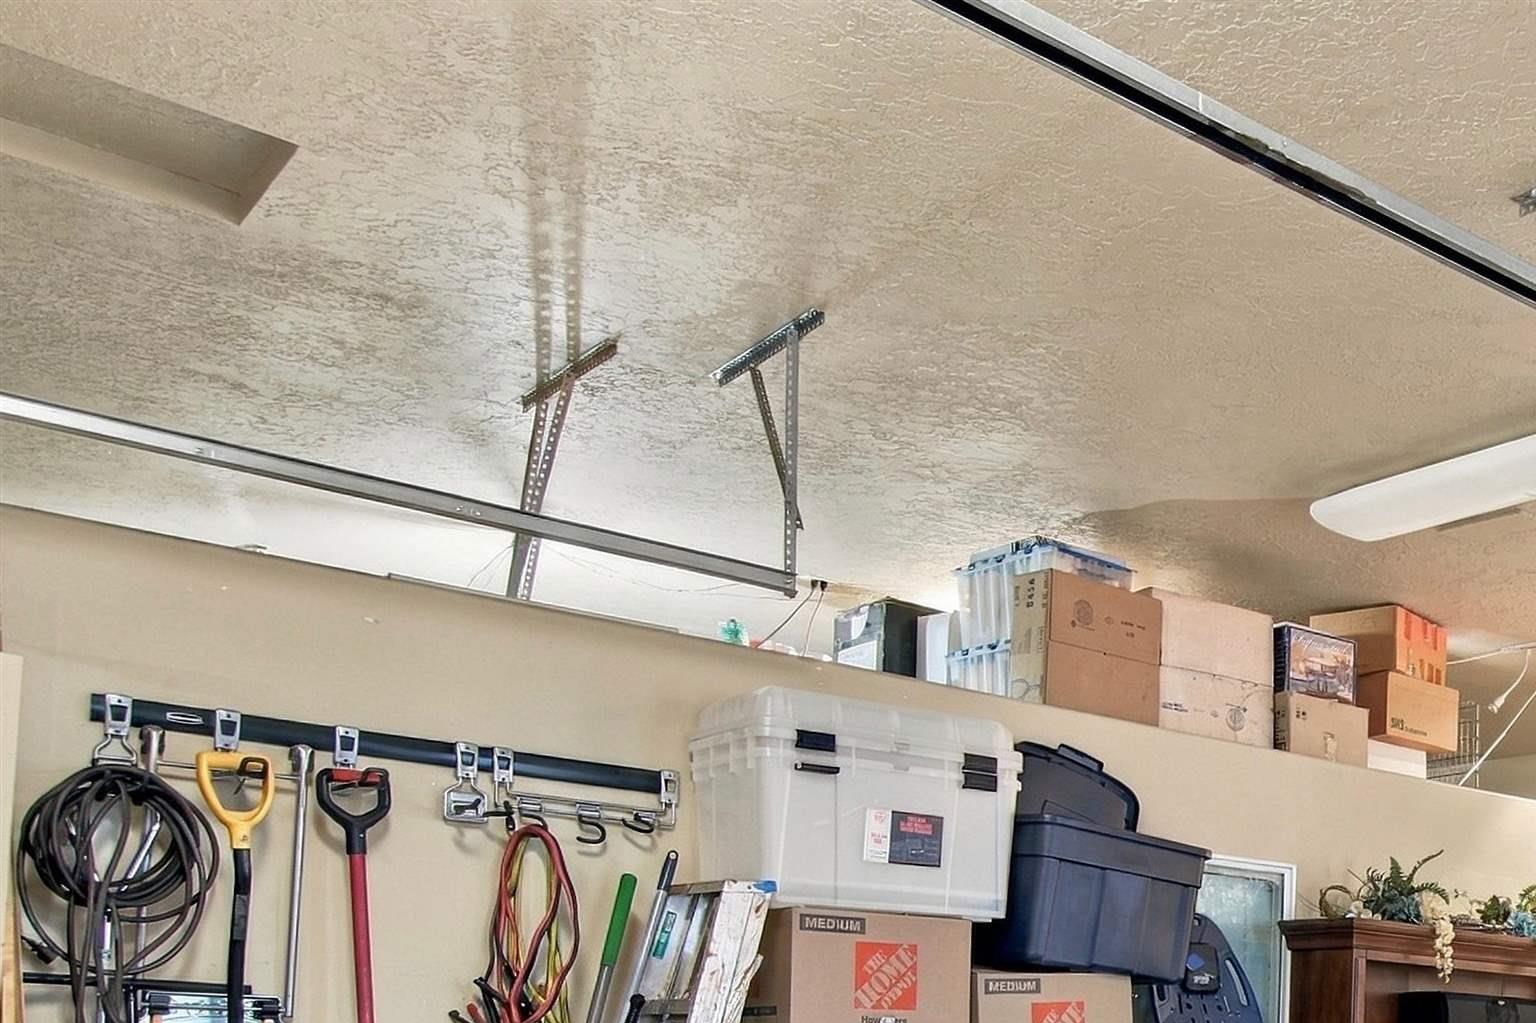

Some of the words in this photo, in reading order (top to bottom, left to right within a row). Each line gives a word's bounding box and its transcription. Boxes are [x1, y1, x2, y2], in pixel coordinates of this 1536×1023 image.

[804, 916, 862, 932] MEDIUM
[854, 944, 918, 1010] HOME
[880, 971, 918, 1010] DEPOT
[988, 981, 1037, 992] MEDIUM
